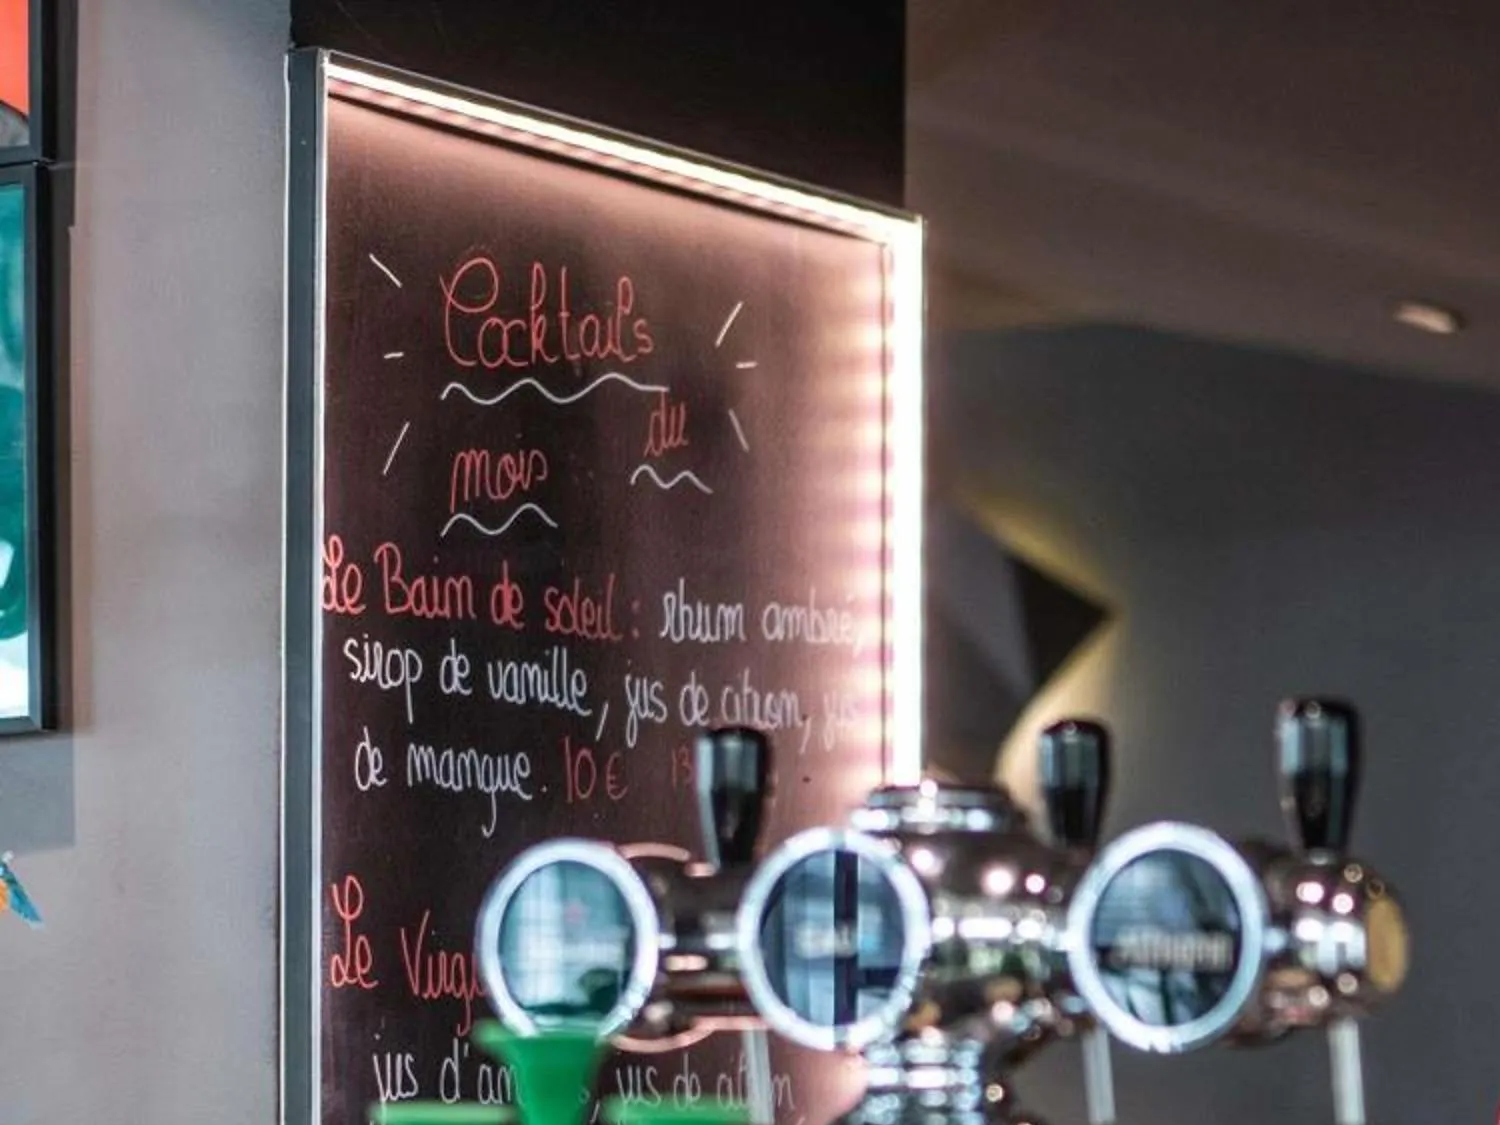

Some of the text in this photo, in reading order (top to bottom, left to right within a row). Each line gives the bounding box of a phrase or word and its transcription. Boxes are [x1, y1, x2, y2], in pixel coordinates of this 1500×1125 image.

[440, 256, 654, 368] Cocktails
[643, 389, 689, 456] du
[449, 446, 549, 513] mois
[374, 543, 476, 624] Bain
[489, 560, 525, 629] de
[544, 572, 623, 641] soleil
[658, 577, 748, 642] rhum
[342, 636, 422, 724] sirop
[439, 640, 472, 698] de
[623, 659, 668, 749] jus
[679, 675, 711, 728] de
[353, 727, 388, 791] de
[330, 875, 379, 988] Le
[672, 1053, 702, 1110] de
